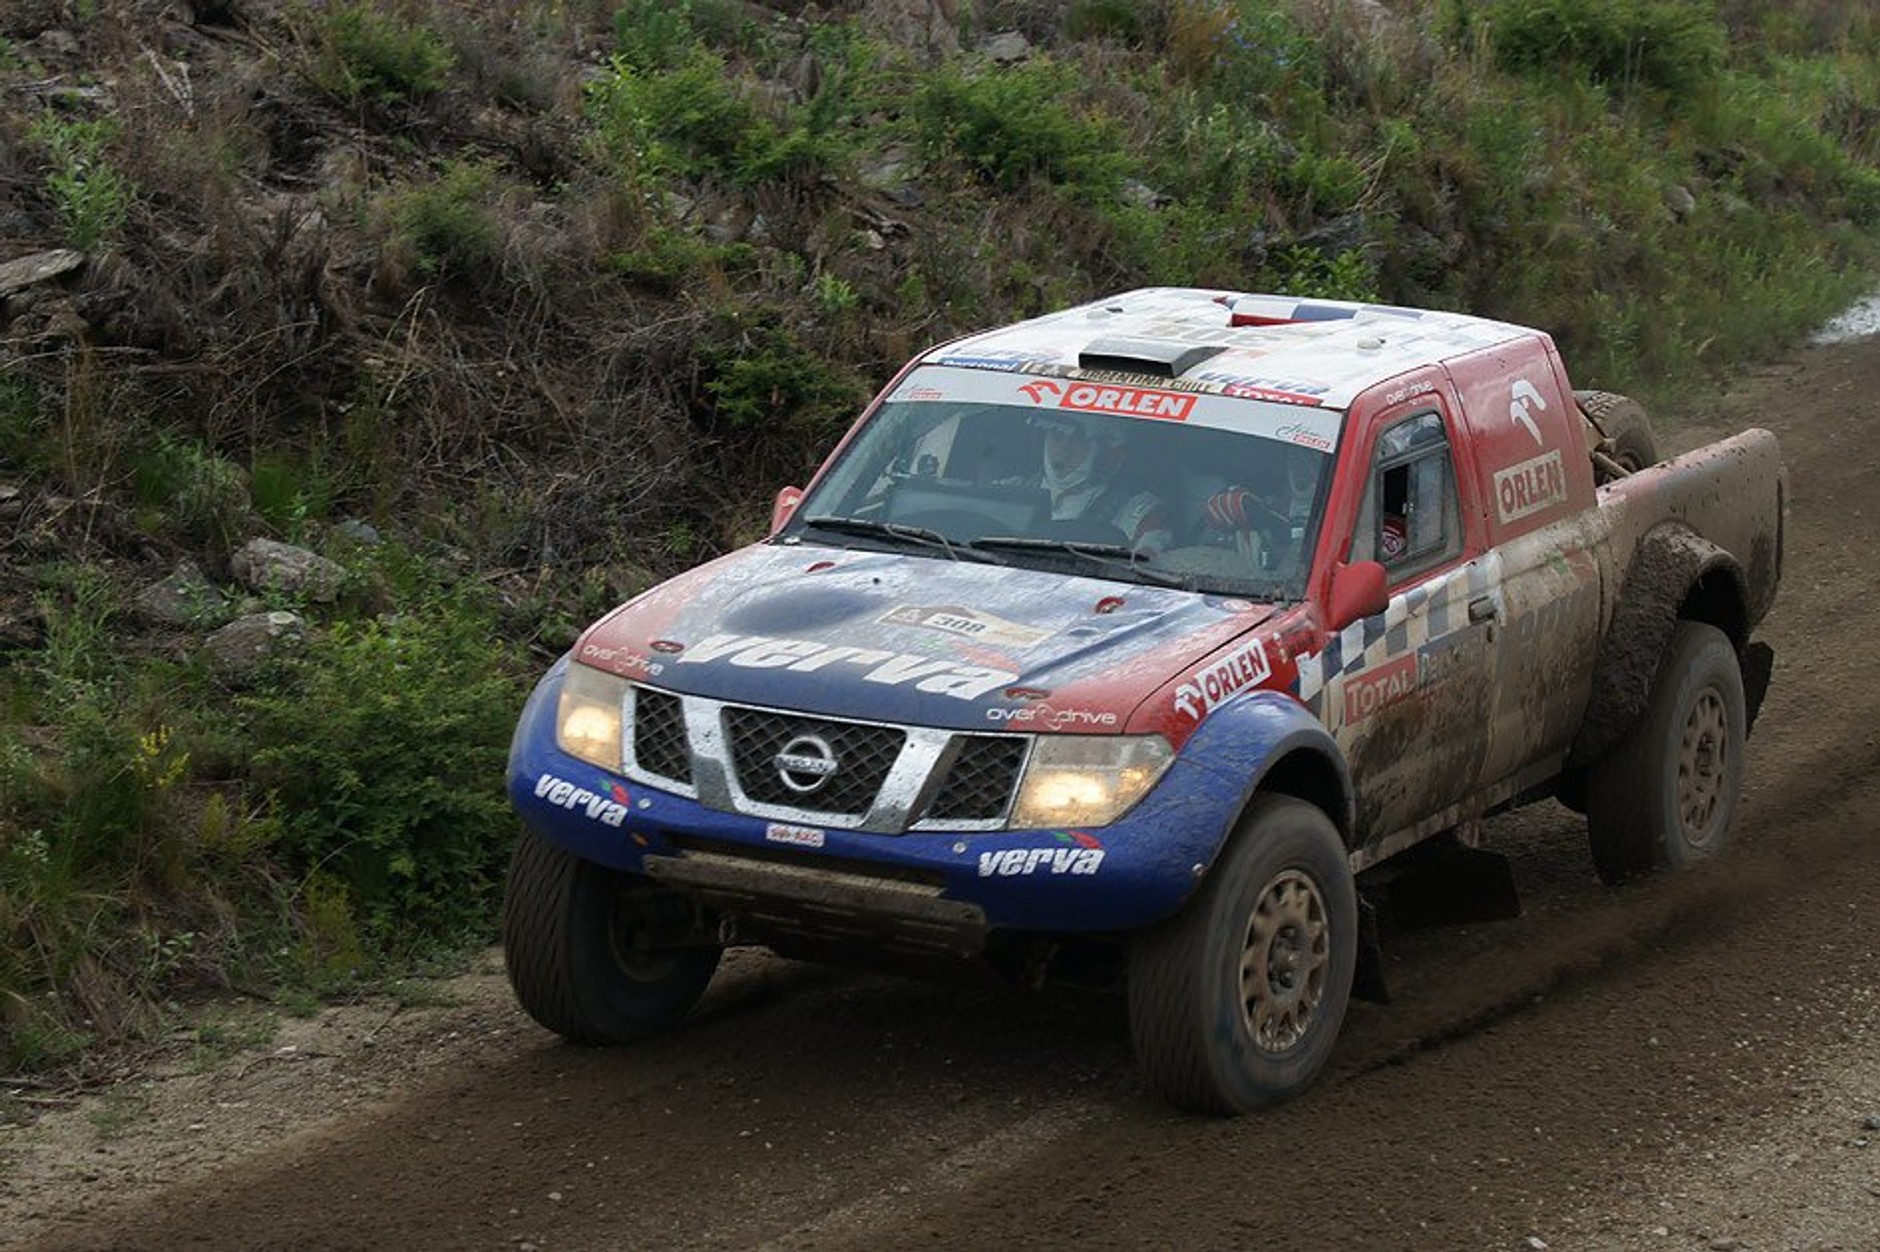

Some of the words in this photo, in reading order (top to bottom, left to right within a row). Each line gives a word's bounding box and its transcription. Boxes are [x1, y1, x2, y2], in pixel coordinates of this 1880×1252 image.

[1070, 386, 1187, 417] ORLEN
[1500, 459, 1562, 514] ORLEN
[676, 634, 1019, 701] verva
[1205, 646, 1265, 702] ORLEN
[1347, 668, 1418, 717] TOTAL
[534, 773, 628, 827] verva
[979, 847, 1106, 878] verva
